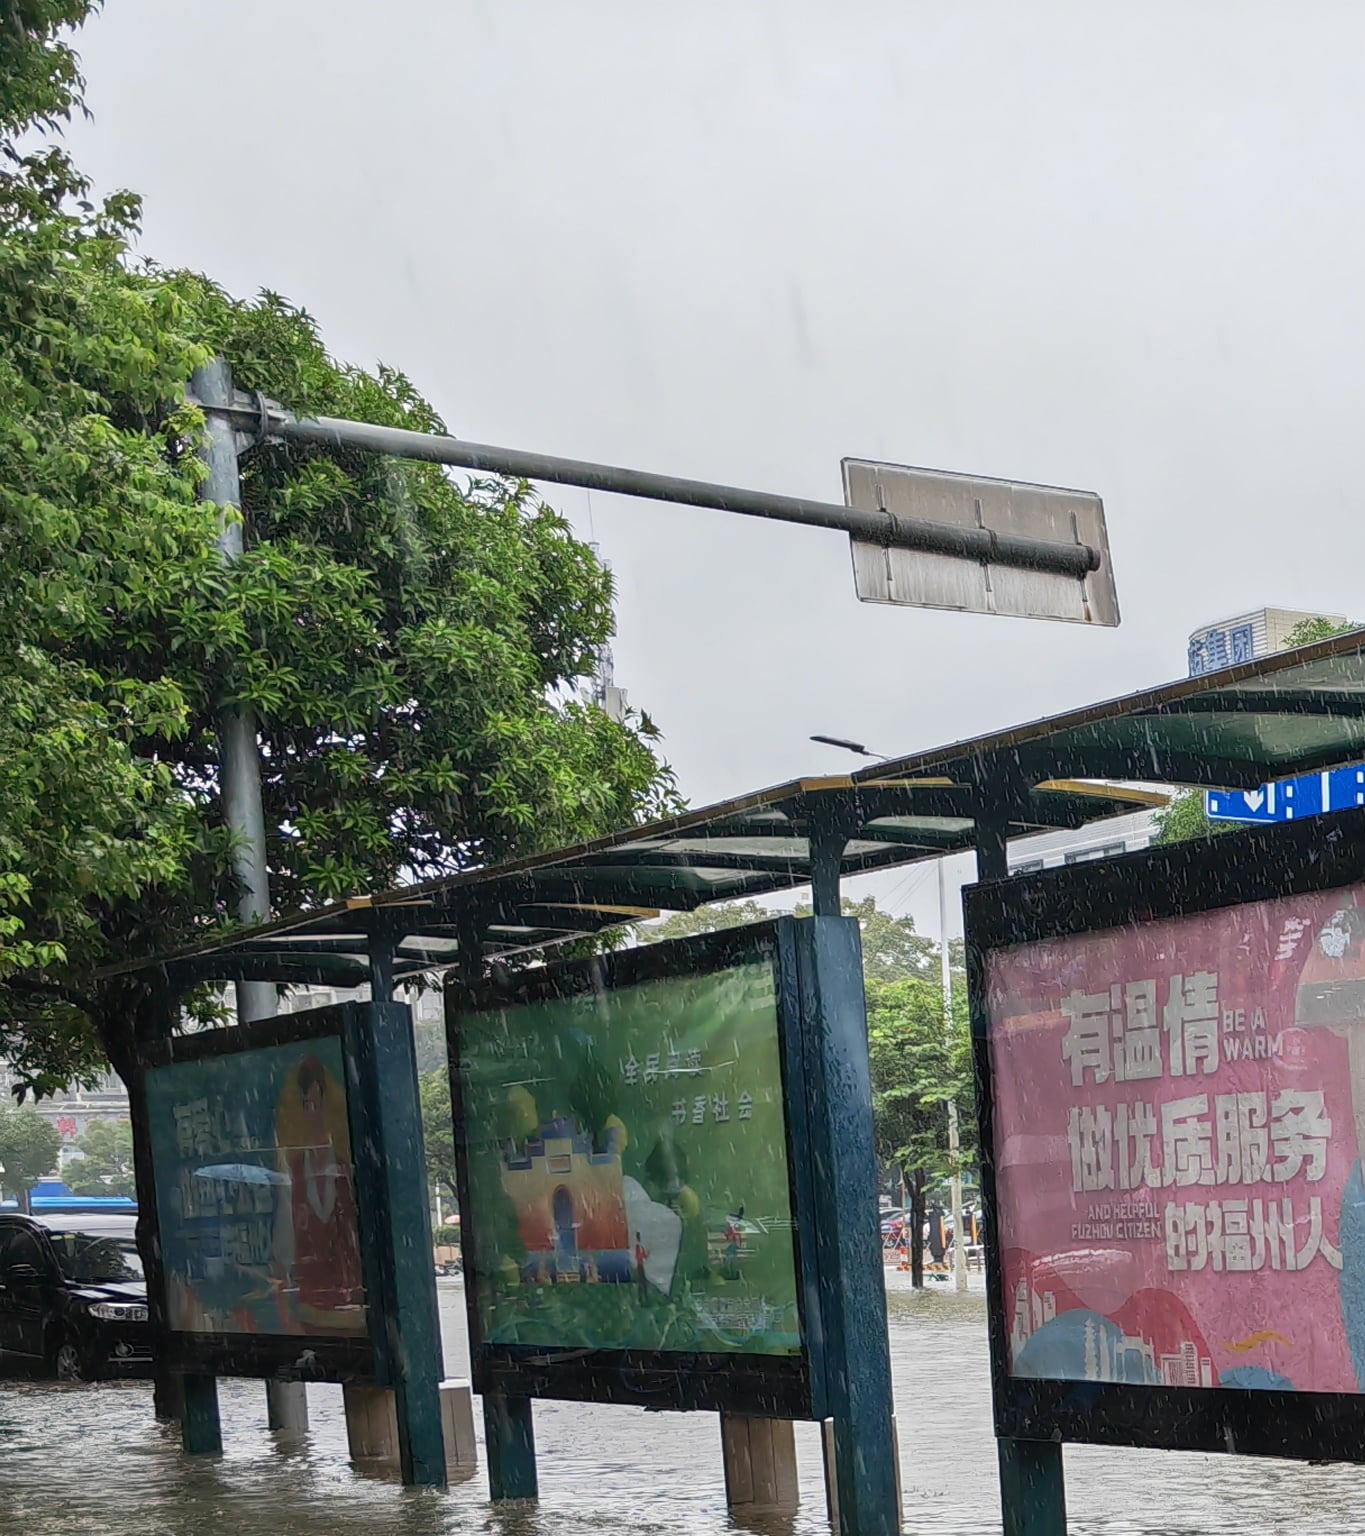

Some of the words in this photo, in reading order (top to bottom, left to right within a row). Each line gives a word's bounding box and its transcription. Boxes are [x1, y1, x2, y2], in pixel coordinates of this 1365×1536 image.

[1060, 970, 1220, 1087] 有温情
[1222, 1008, 1245, 1032] BE
[1224, 1033, 1284, 1062] WARM
[671, 1089, 754, 1125] 书香社会
[1066, 1088, 1332, 1194] 做优质服务
[1087, 1204, 1111, 1220] AND
[1113, 1201, 1161, 1219] HELPFUL
[1071, 1223, 1114, 1240] FUZHOU
[1116, 1221, 1161, 1239] CITIZEN
[1165, 1196, 1344, 1272] 的福州人
